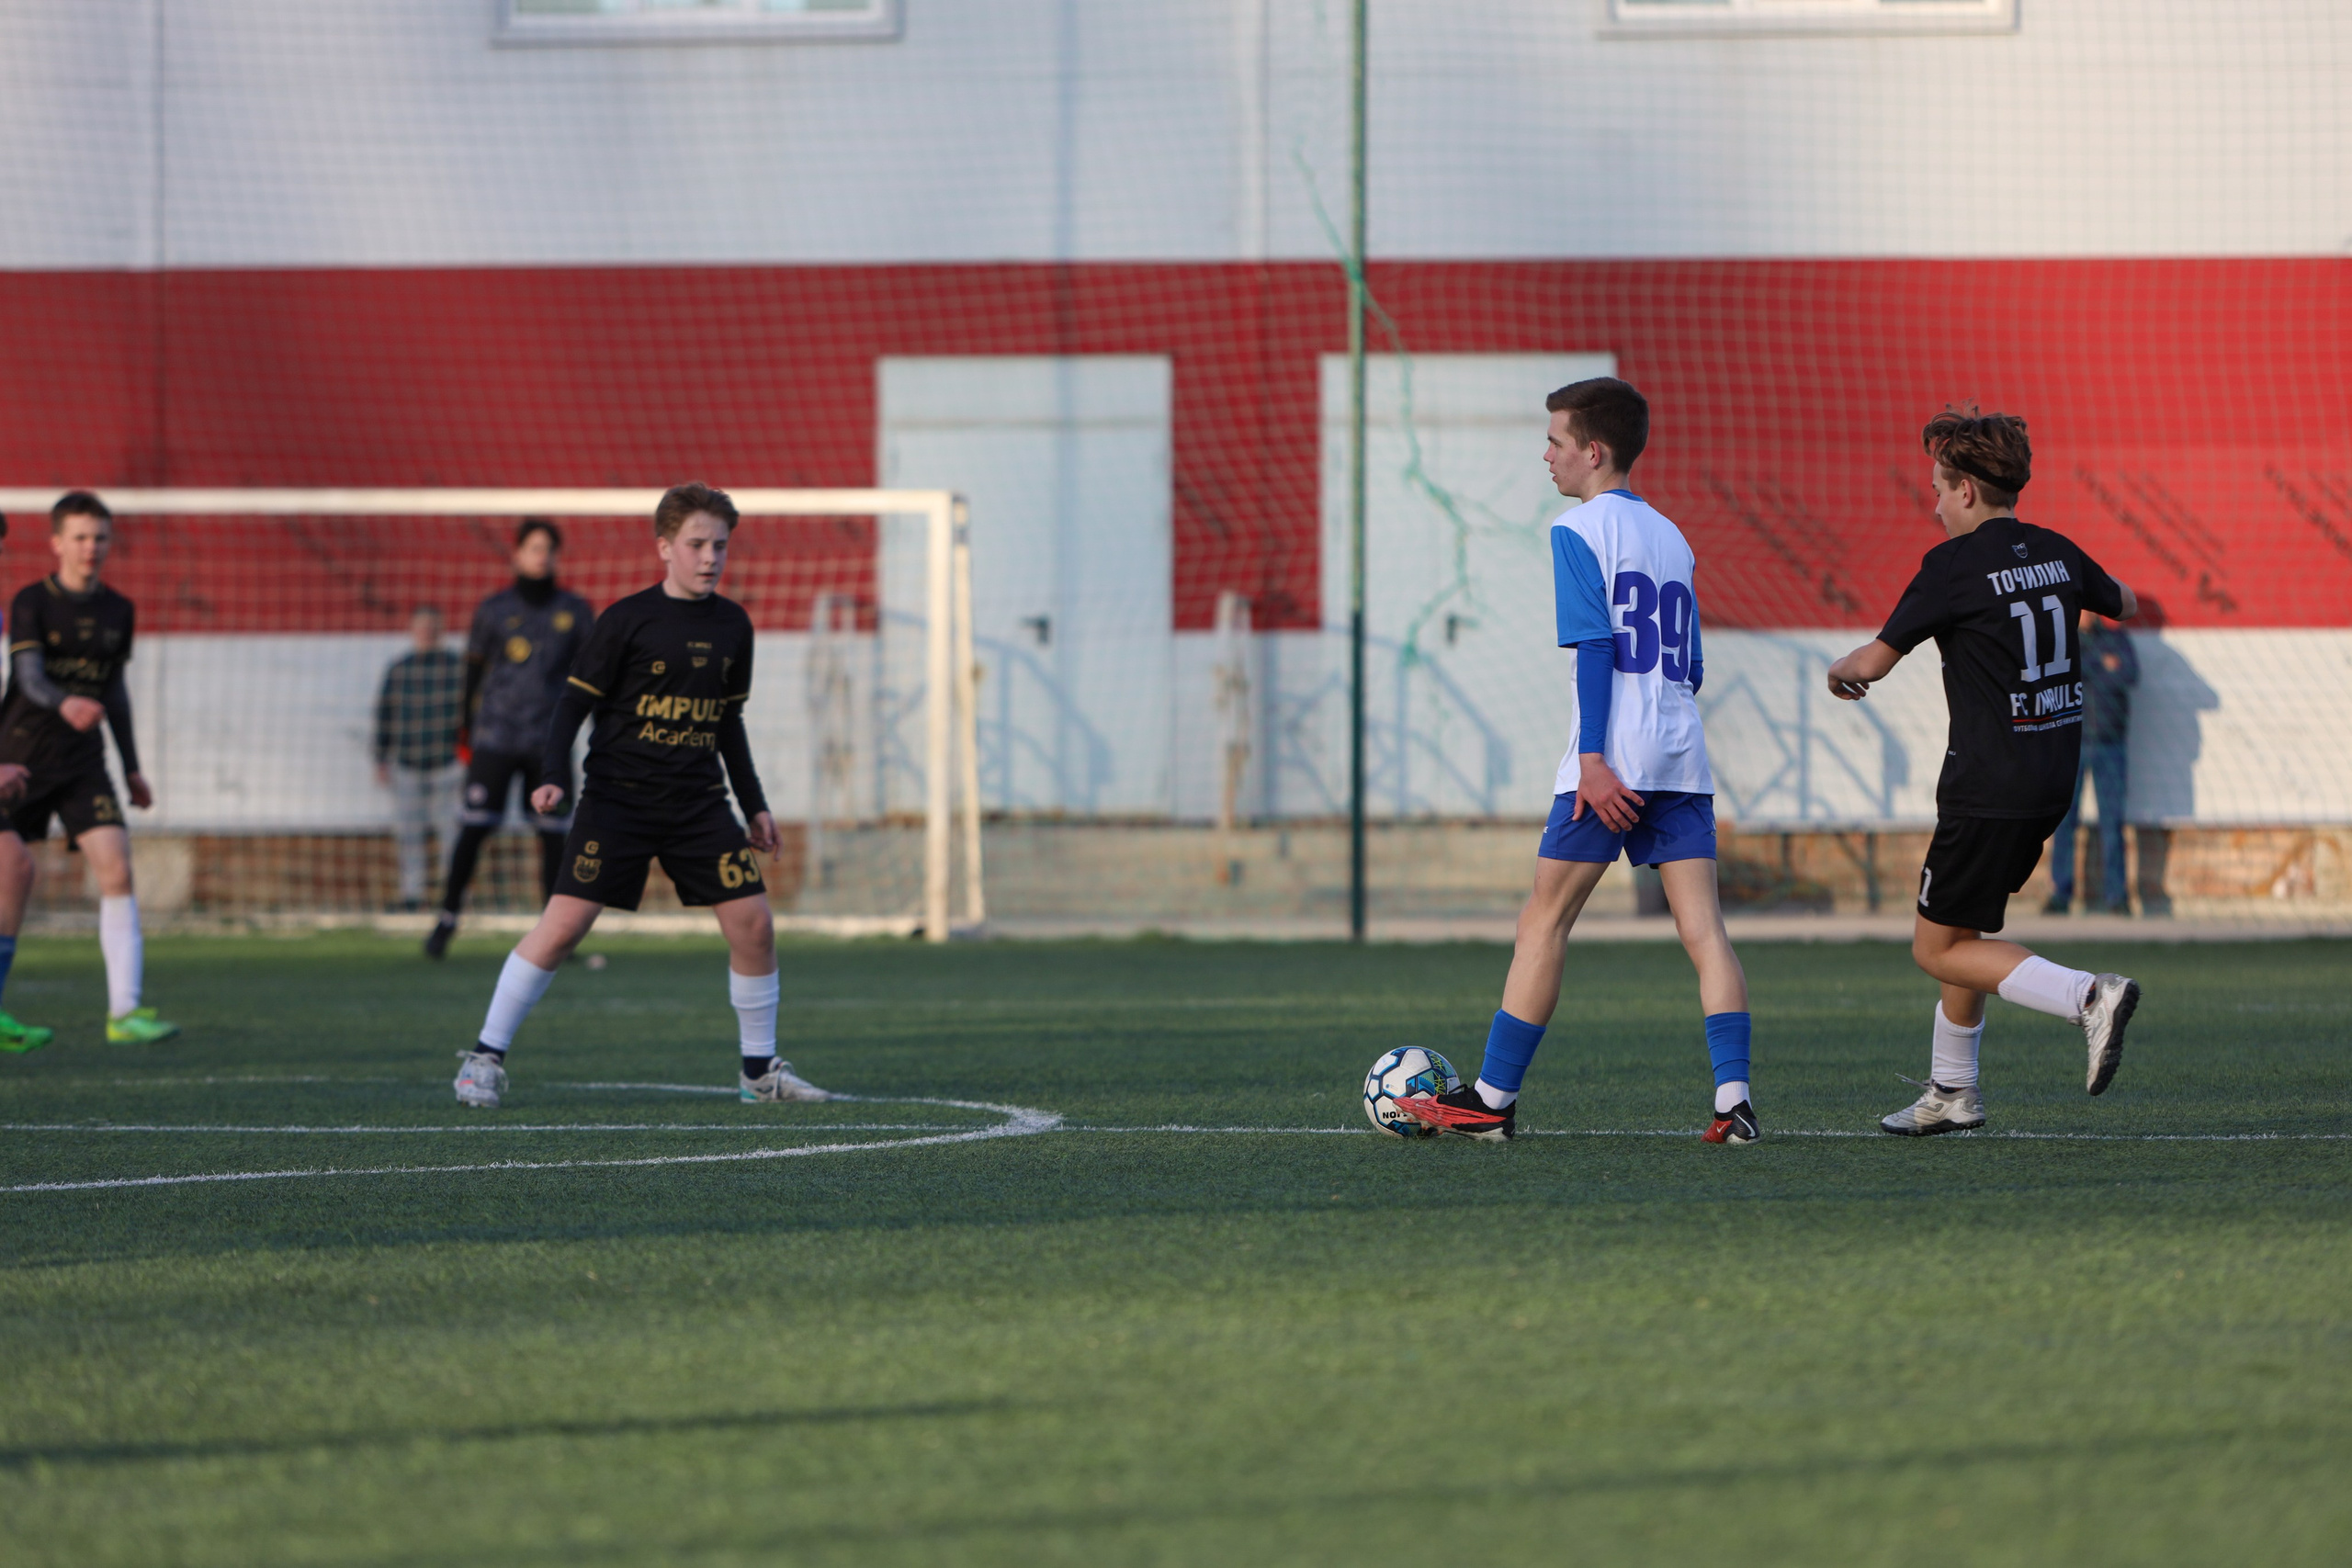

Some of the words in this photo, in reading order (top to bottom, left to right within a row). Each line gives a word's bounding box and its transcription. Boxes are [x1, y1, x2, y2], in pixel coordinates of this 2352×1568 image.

[1986, 559, 2071, 596] ТОЧИЛИН
[1612, 570, 1692, 682] 39
[2009, 594, 2071, 682] 11
[2009, 692, 2029, 716] FC
[718, 847, 760, 888] 63
